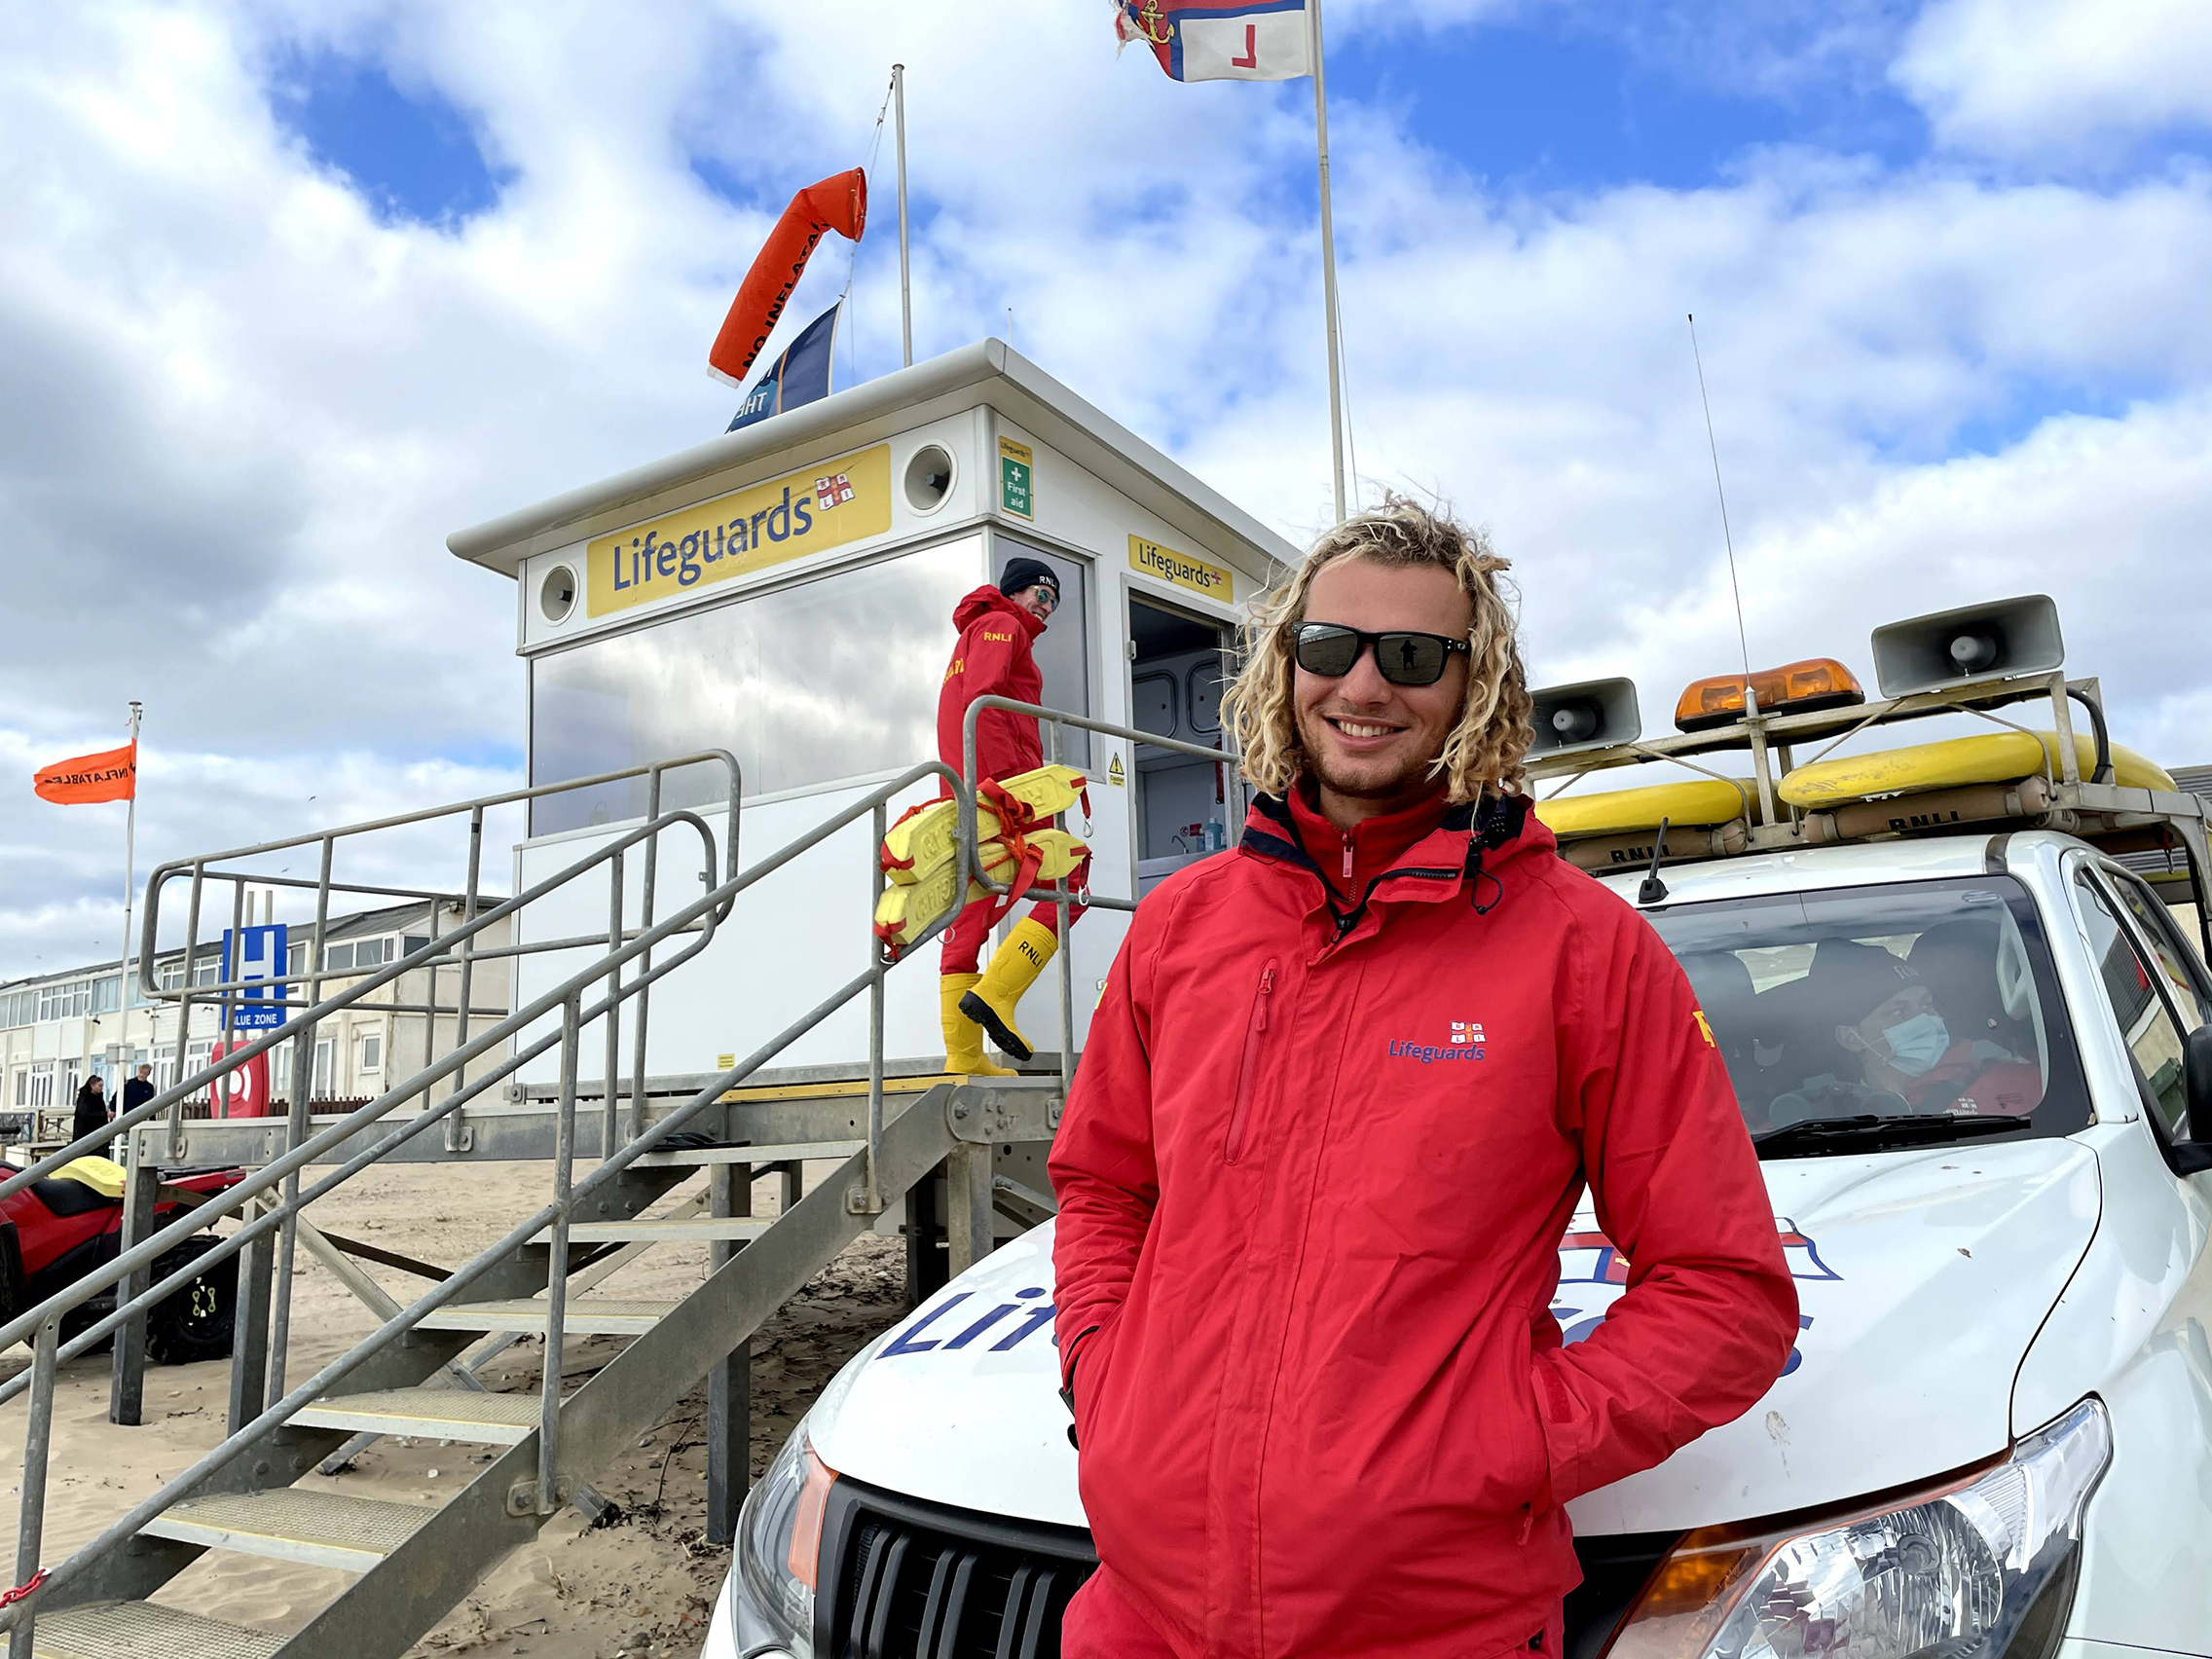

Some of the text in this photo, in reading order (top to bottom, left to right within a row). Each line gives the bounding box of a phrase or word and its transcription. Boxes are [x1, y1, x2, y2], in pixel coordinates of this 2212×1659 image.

[742, 336, 766, 369] NO
[1007, 481, 1026, 497] First
[1011, 498, 1024, 509] aid
[614, 486, 812, 591] Lifeguards
[1139, 543, 1211, 588] Lifeguards
[983, 632, 1013, 643] RNLI
[1889, 810, 1960, 830] RNLI
[1609, 844, 1672, 864] RNLI
[1018, 940, 1044, 968] RNLI
[254, 1013, 277, 1025] ZONE
[1389, 1040, 1485, 1064] Lifeguards
